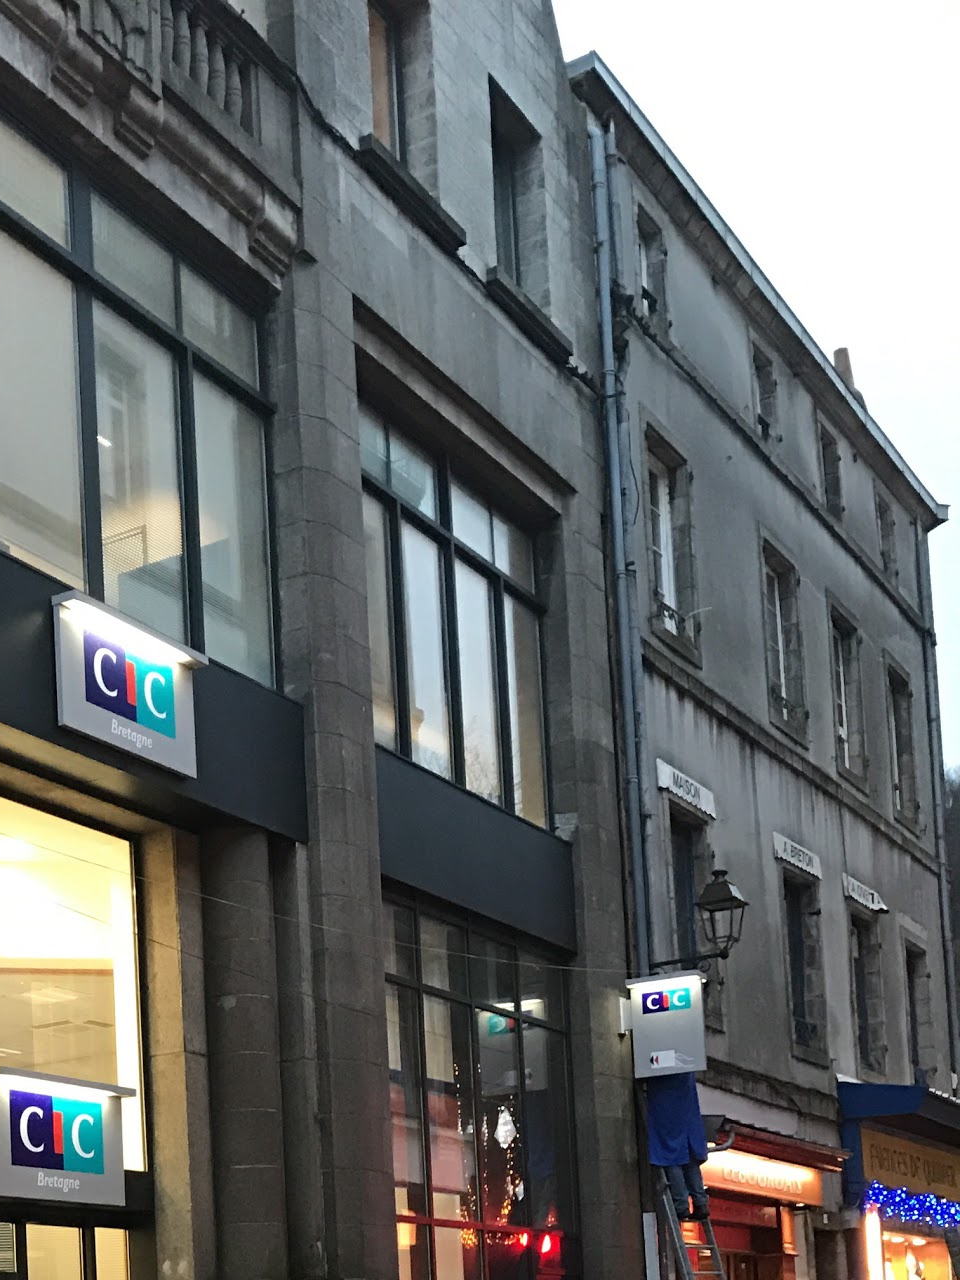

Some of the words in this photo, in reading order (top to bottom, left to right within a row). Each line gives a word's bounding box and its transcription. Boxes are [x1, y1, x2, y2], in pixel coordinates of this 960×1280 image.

[93, 647, 167, 719] CIC
[111, 719, 153, 748] Bretagne
[673, 771, 701, 802] MAISON
[790, 845, 814, 869] BRETON
[646, 990, 686, 1010] CIC
[19, 1105, 95, 1159] CIC
[37, 1172, 80, 1192] Bretagne
